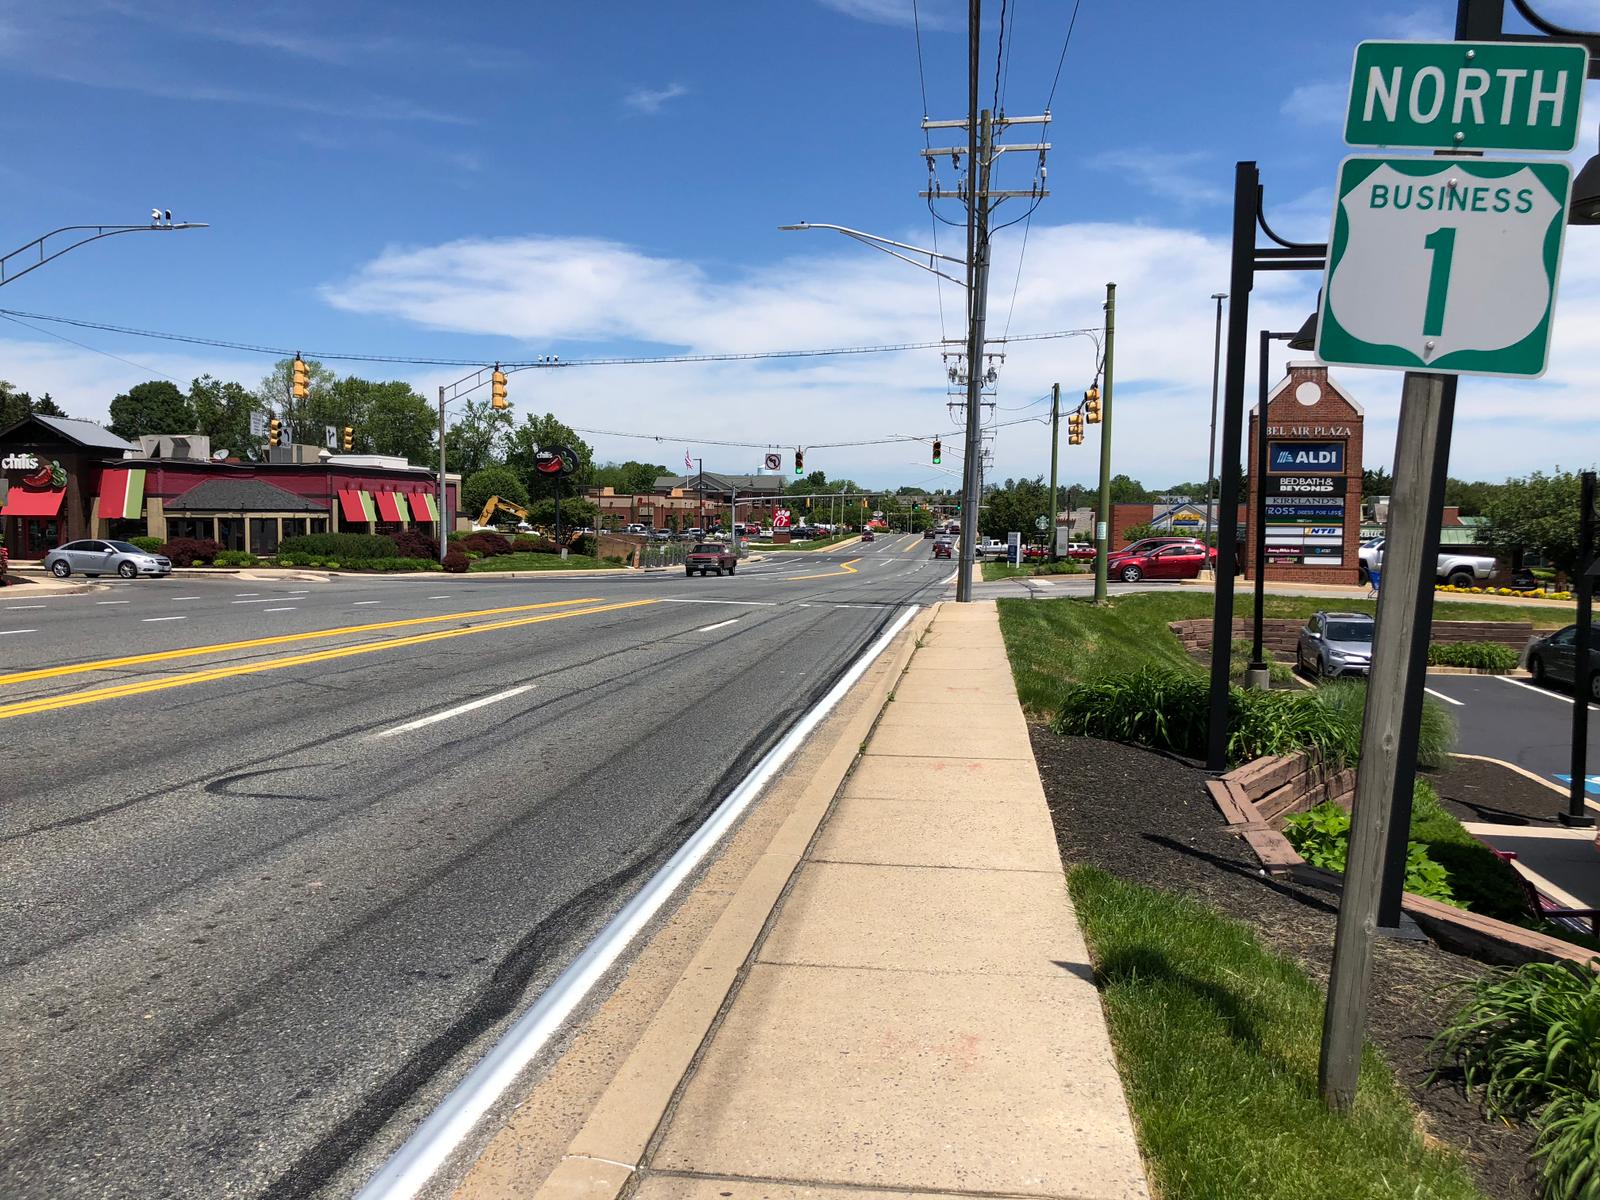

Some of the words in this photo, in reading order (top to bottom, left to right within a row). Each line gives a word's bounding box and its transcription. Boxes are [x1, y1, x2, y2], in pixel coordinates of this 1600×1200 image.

[1362, 65, 1568, 127] NORTH
[1369, 184, 1534, 214] BUSINESS
[1423, 227, 1457, 337] 1
[1266, 426, 1287, 436] BEL
[1290, 426, 1310, 436] AIR
[1314, 427, 1352, 436] PLAZA
[1295, 451, 1337, 464] ALDI
[1280, 477, 1301, 485] BED
[1300, 477, 1325, 486] BATH
[1324, 477, 1334, 486] &
[1272, 497, 1338, 505] KIRKLAND'S
[1265, 507, 1296, 515] ROSS
